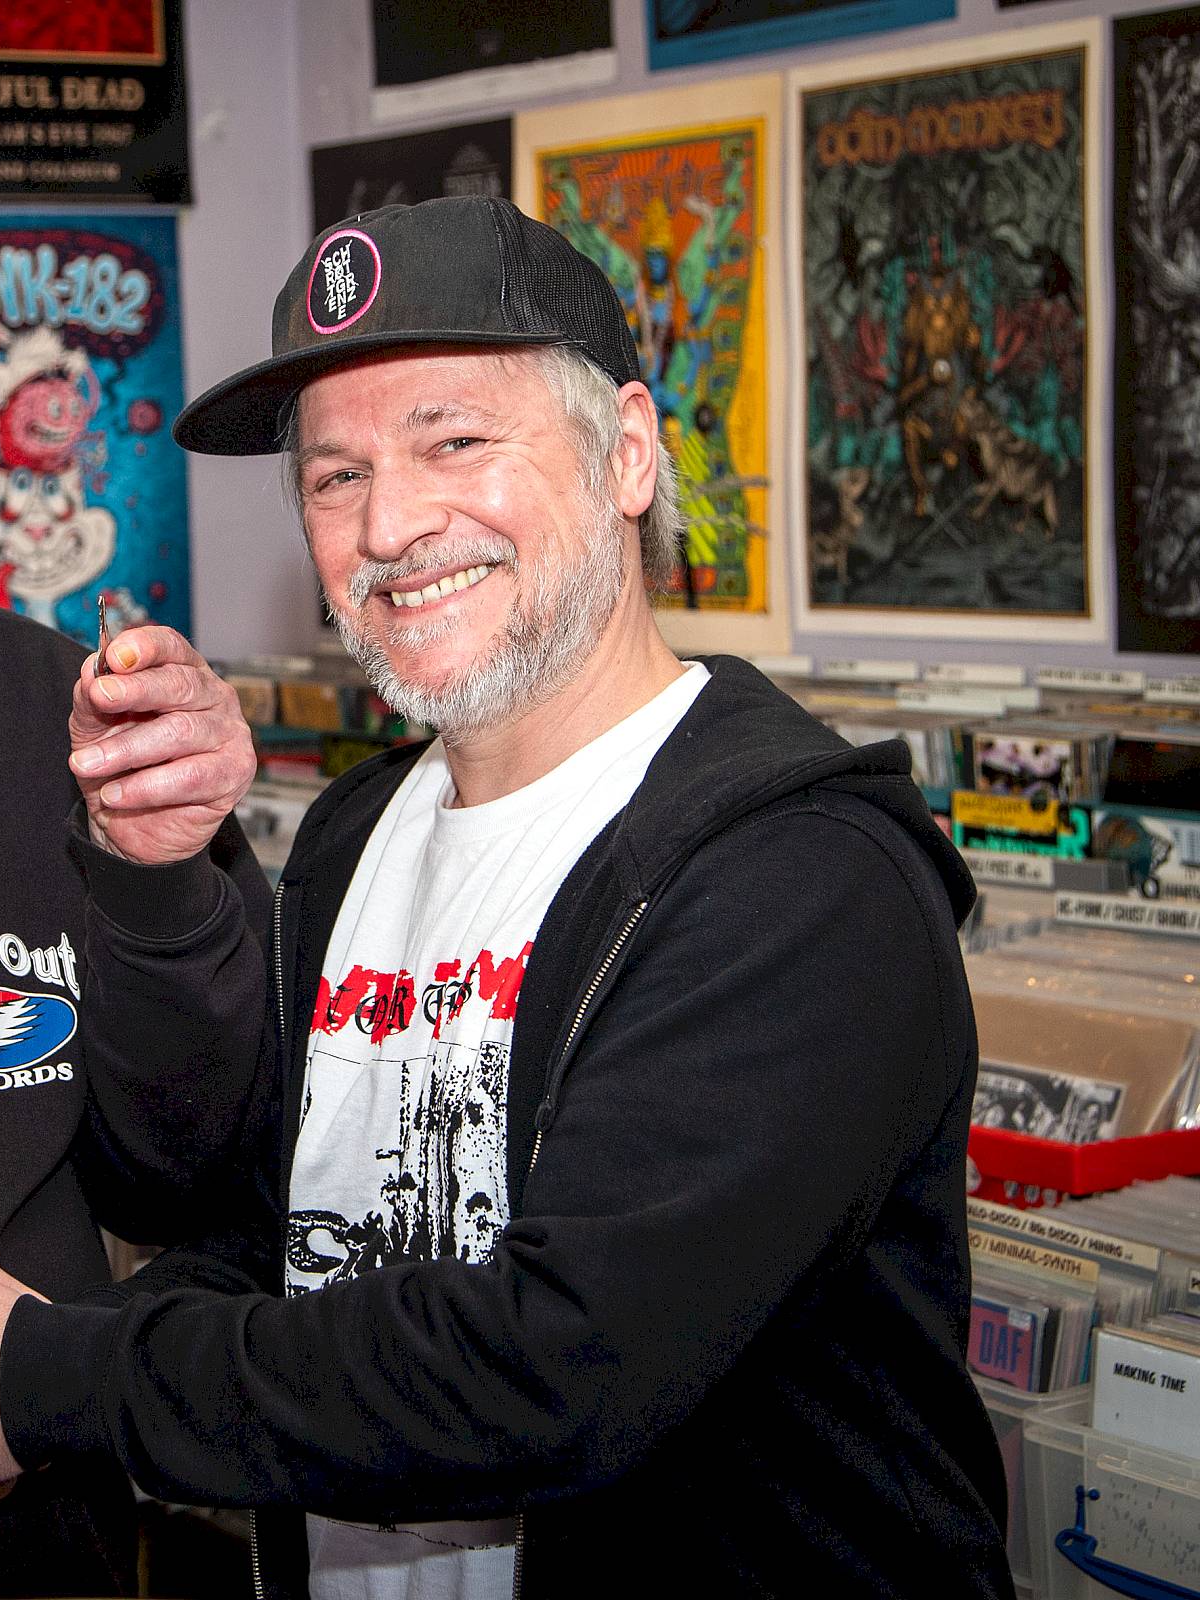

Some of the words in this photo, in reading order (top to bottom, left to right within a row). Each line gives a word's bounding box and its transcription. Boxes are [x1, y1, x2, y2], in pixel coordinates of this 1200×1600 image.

[61, 76, 145, 111] DEAD
[1048, 1226, 1080, 1246] DISCO
[990, 1239, 1082, 1276] MINIMAL-SYNTH
[1113, 1362, 1156, 1385] MAKING
[1160, 1374, 1188, 1393] TIME
